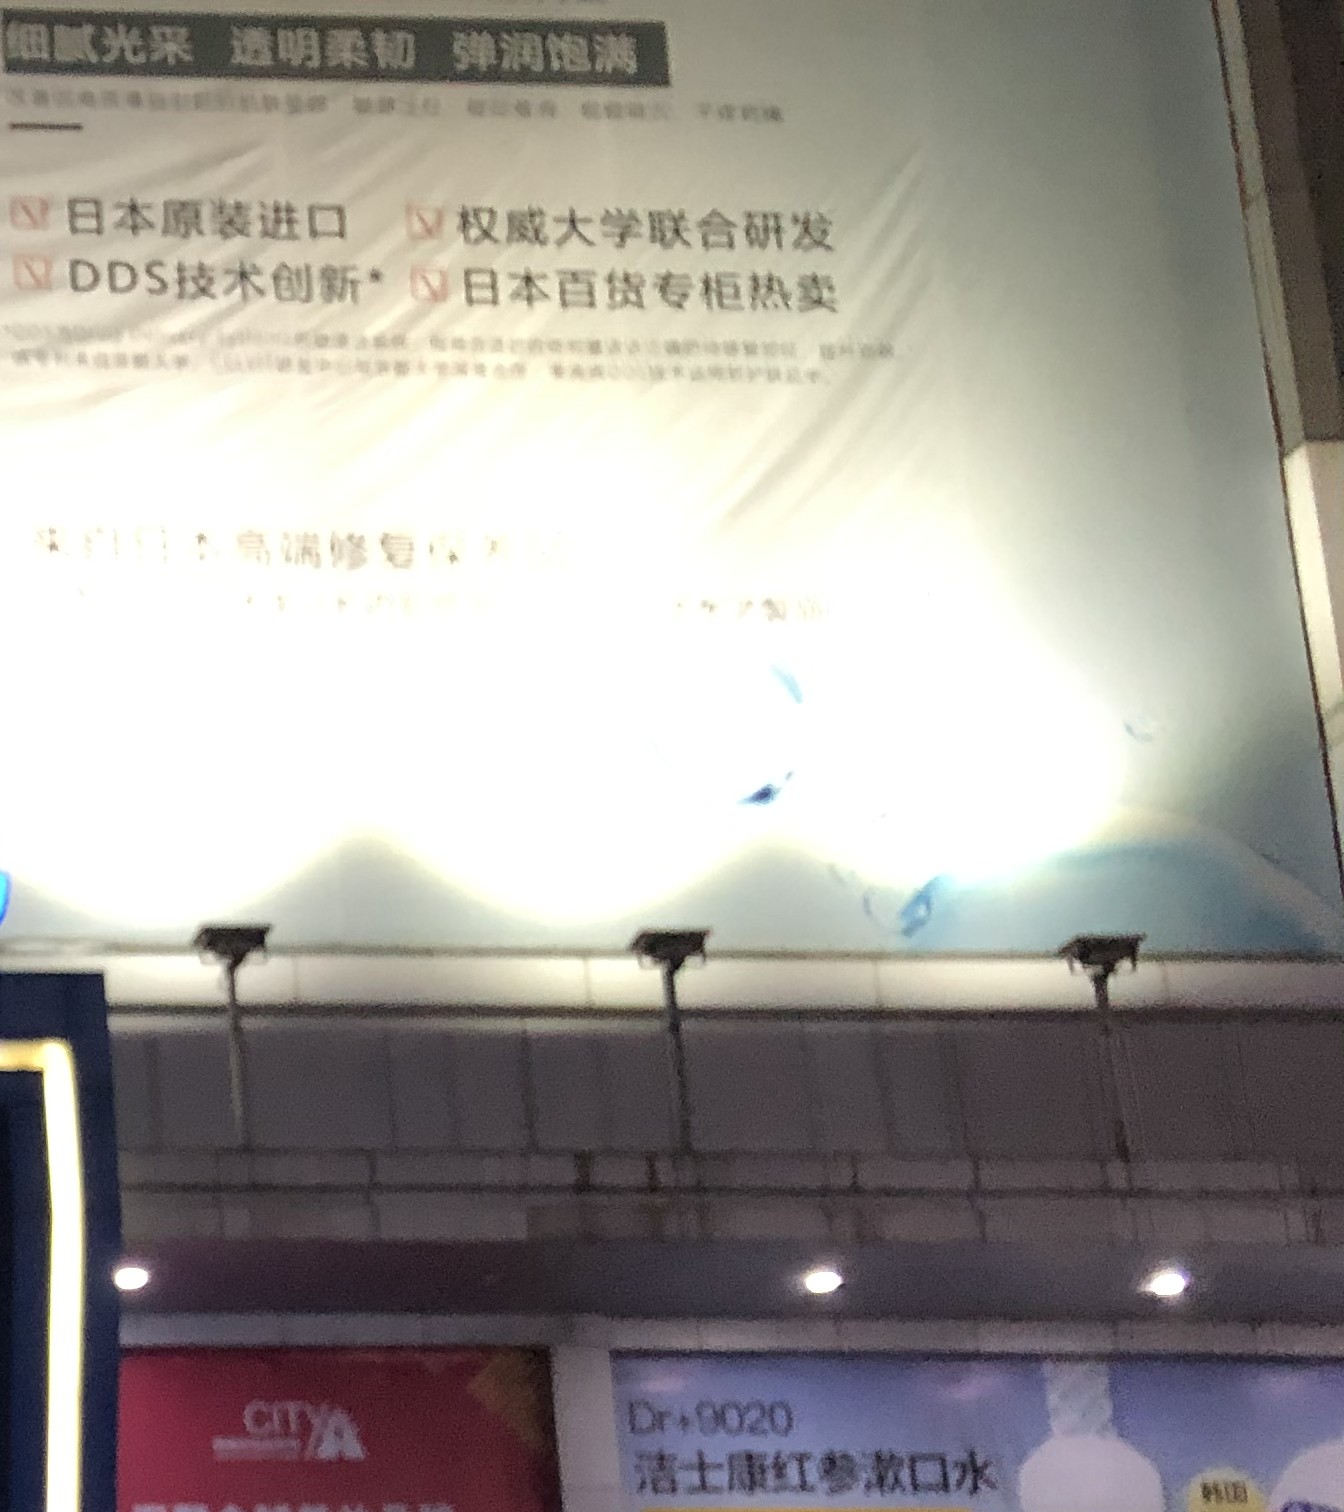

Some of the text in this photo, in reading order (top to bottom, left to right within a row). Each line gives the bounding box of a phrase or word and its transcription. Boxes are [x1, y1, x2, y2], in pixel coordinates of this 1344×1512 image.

[67, 198, 348, 240] 日本原装进口
[457, 205, 836, 252] 权威大学联合研发
[462, 266, 839, 314] 日本百货专柜热卖
